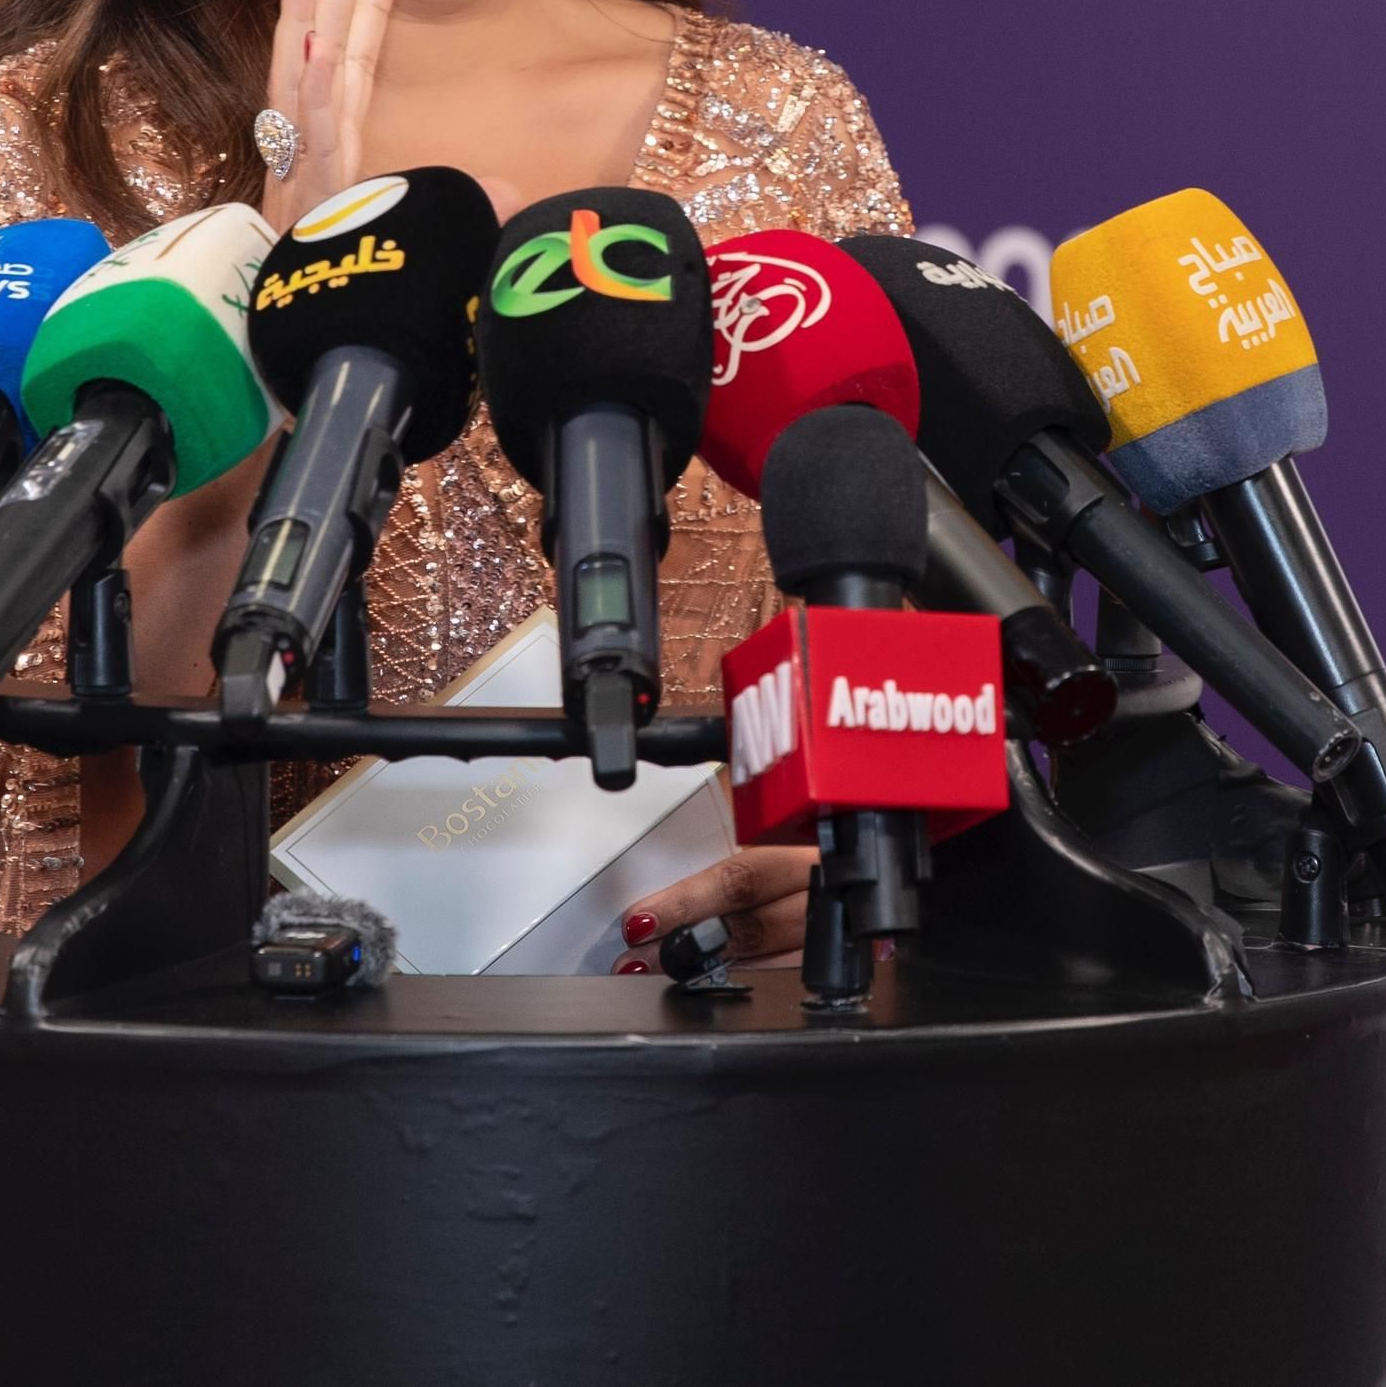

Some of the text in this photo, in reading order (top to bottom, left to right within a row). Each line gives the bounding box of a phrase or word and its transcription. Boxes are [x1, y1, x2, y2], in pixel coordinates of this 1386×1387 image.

[256, 235, 406, 311] خليجية
[1177, 235, 1263, 296] صباح
[1057, 294, 1116, 355] صبا
[1207, 278, 1296, 350] العربية
[827, 676, 997, 735] Arabwood
